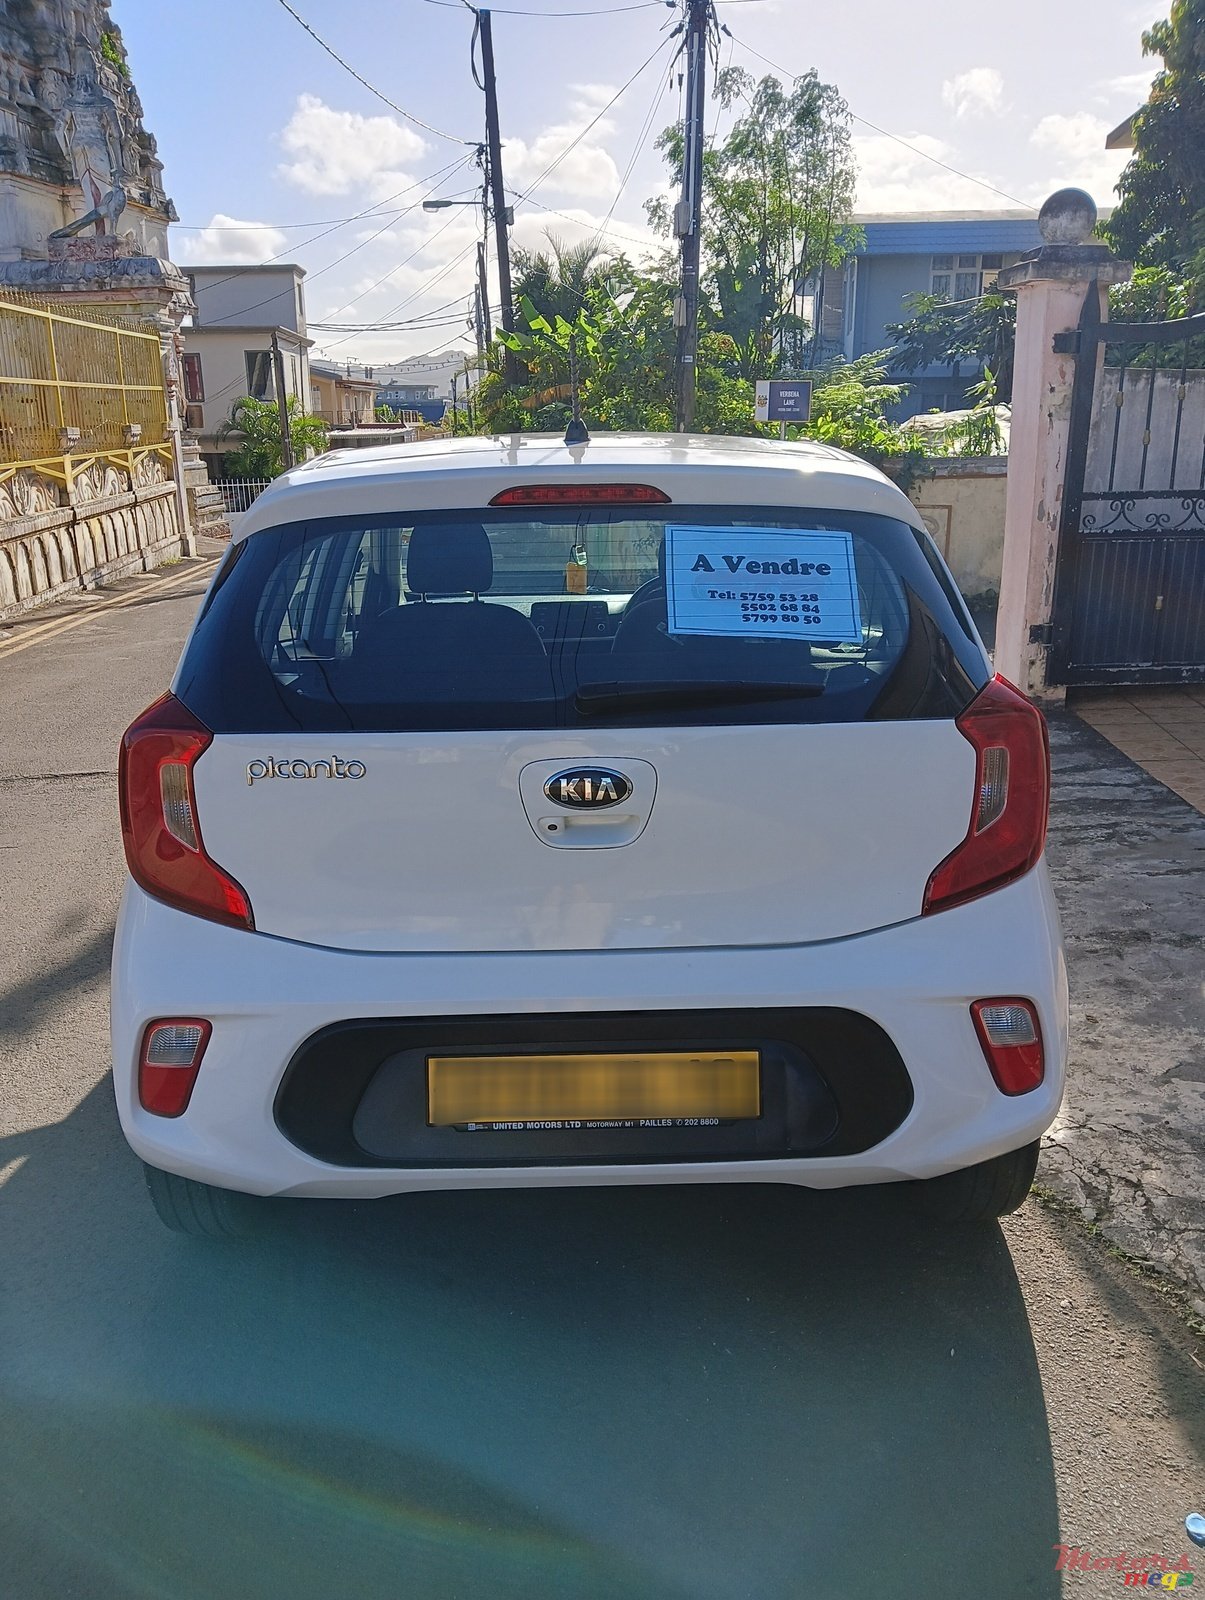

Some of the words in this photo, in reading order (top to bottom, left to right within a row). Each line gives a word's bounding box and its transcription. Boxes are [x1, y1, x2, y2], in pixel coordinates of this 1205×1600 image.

[691, 554, 715, 572] A
[722, 556, 831, 576] Vendre
[708, 590, 736, 600] Tel:
[740, 592, 775, 602] 5759
[779, 593, 797, 602] 53
[800, 593, 818, 602] 28
[740, 603, 776, 612] 5502
[780, 603, 798, 612] 68
[802, 604, 820, 614] 84
[742, 614, 778, 623] 5799
[782, 614, 800, 623] 80
[804, 616, 821, 625] 50
[246, 755, 366, 786] picanto
[560, 777, 618, 801] KIA
